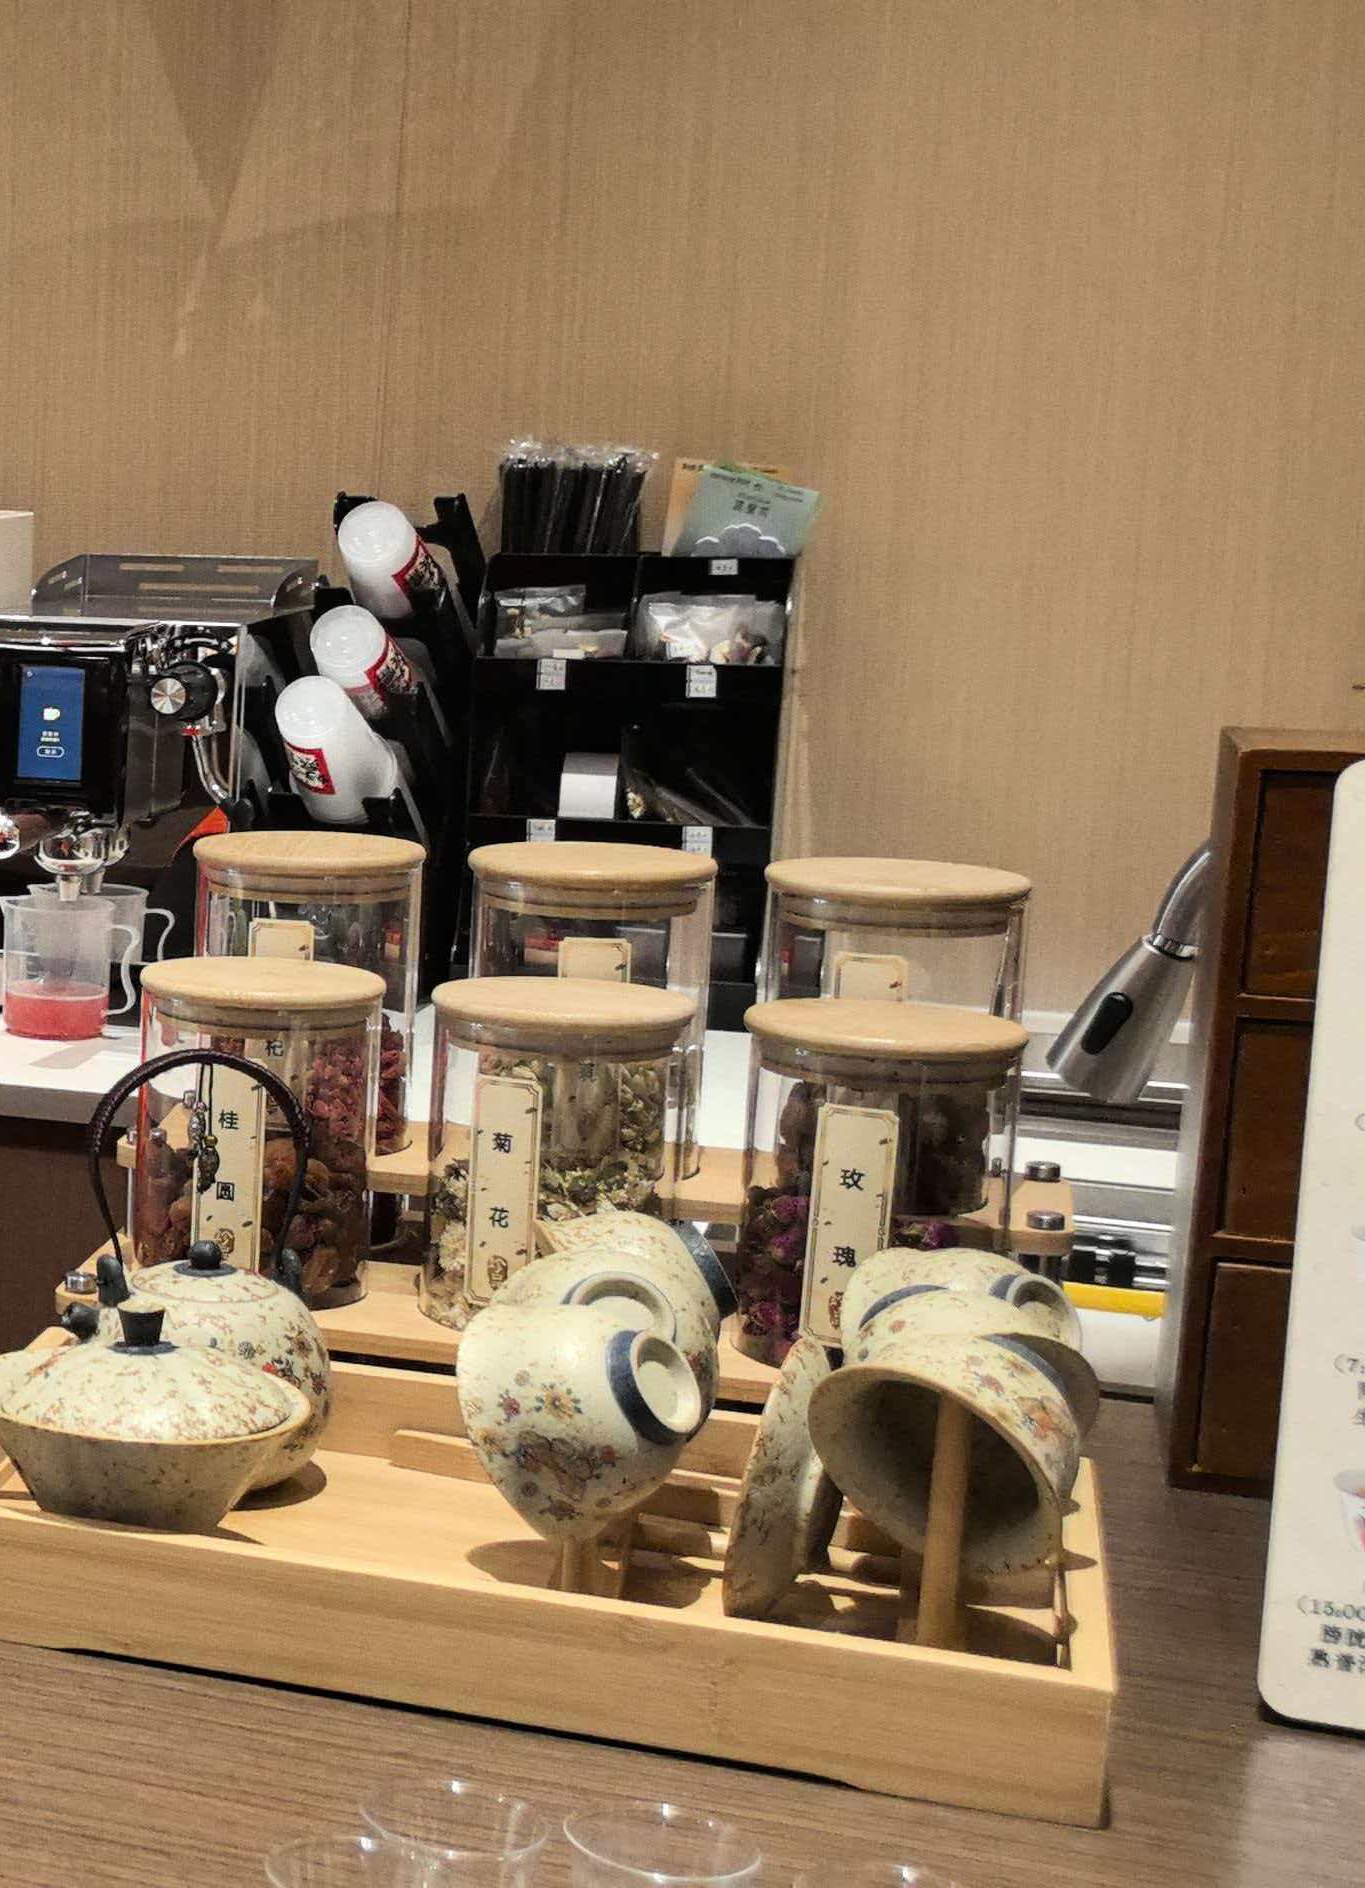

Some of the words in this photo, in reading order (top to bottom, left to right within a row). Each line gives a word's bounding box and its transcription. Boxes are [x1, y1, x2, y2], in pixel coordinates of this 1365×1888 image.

[215, 1108, 239, 1202] 桂圆
[488, 1131, 513, 1229] 菊花
[832, 1167, 866, 1269] 玫瑰
